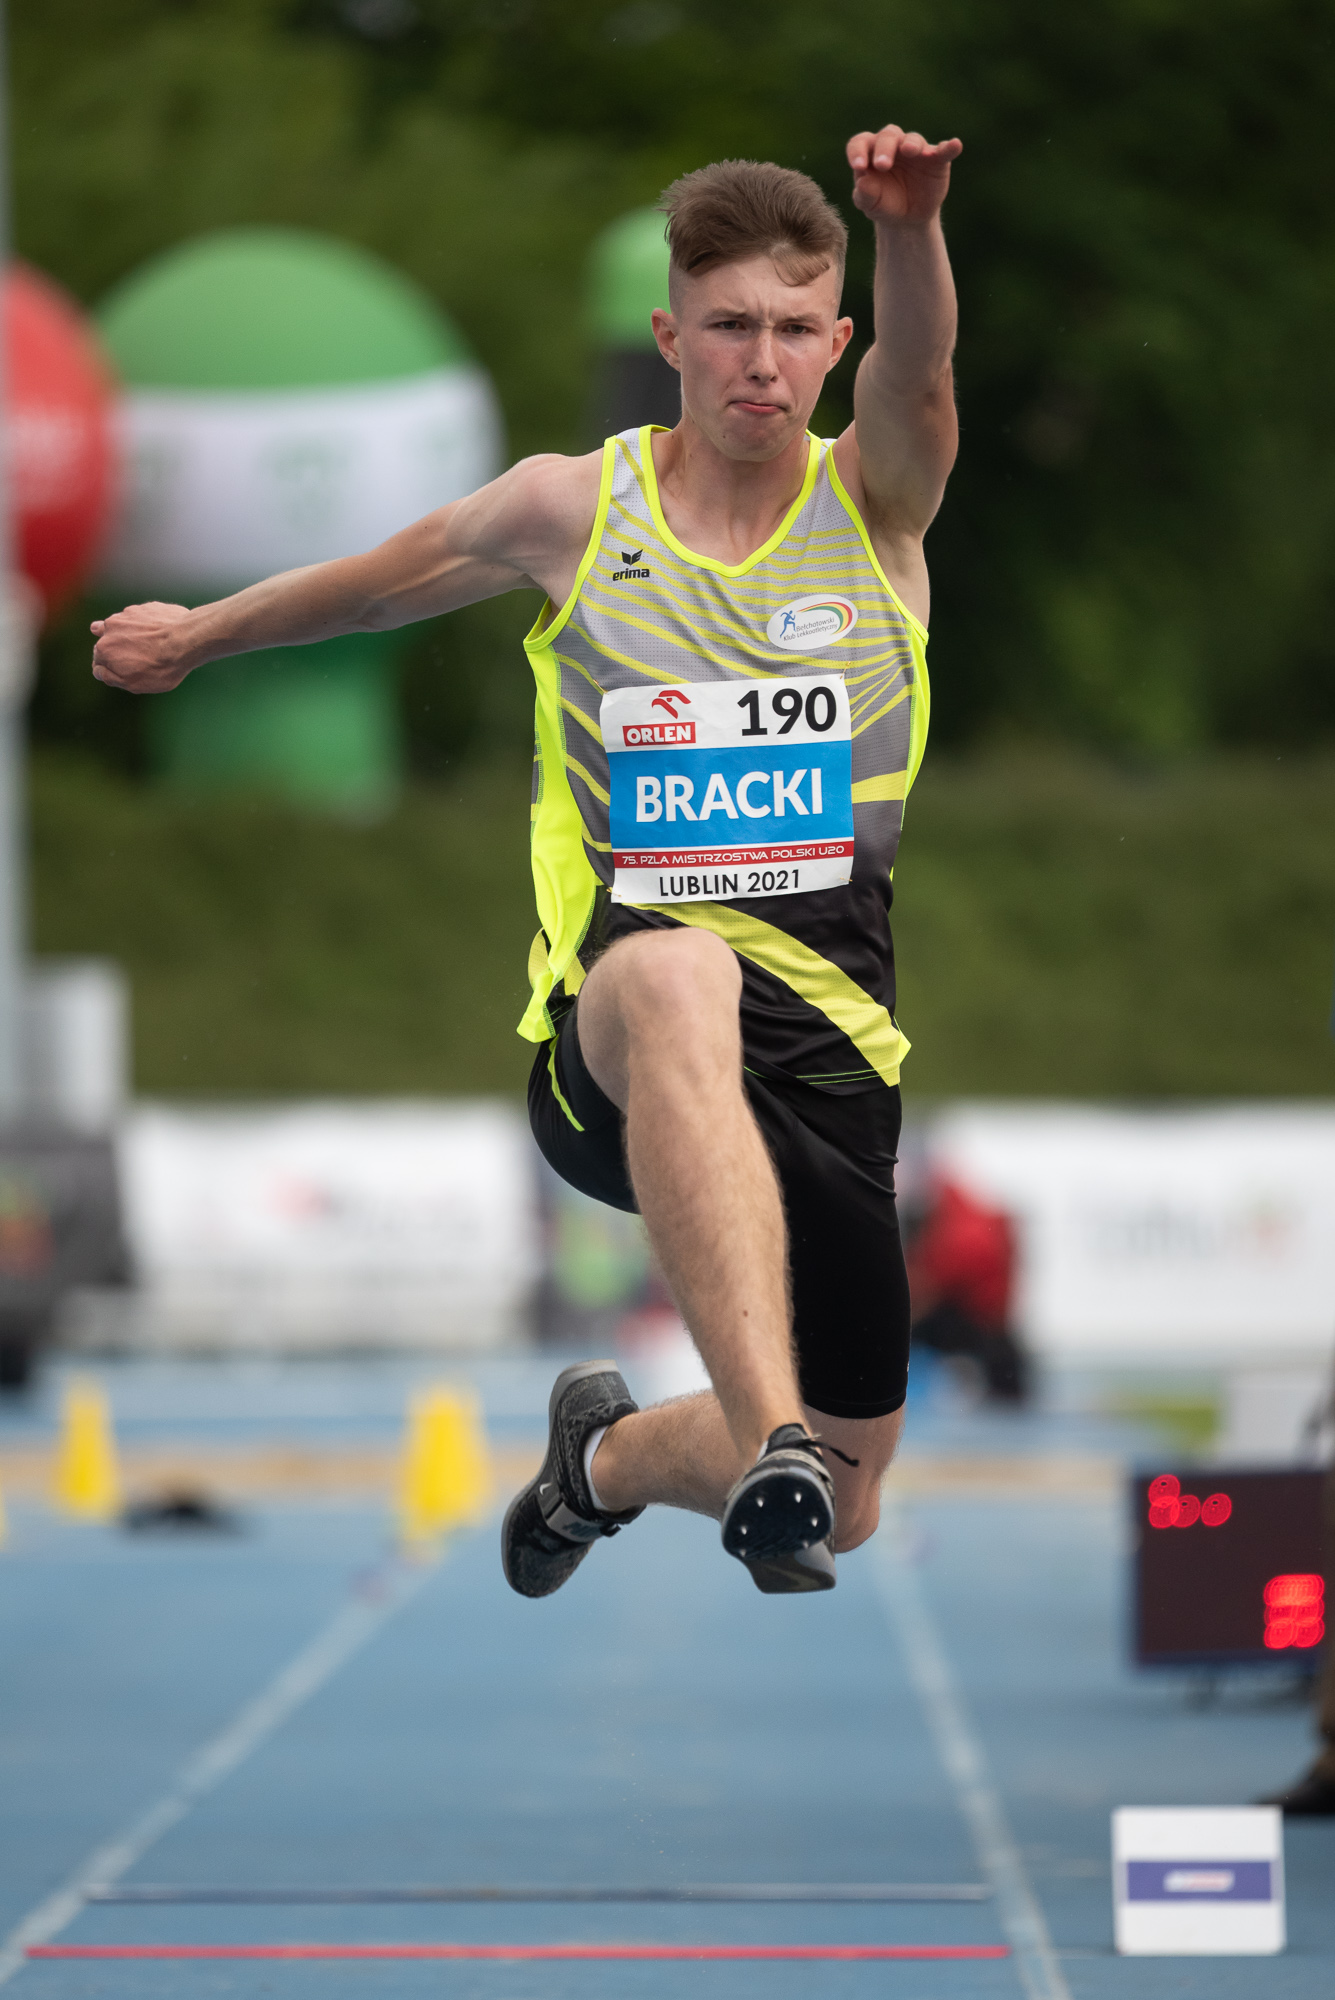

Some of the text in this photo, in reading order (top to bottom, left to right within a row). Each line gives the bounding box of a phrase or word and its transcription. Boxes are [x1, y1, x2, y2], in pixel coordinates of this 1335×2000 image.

[612, 568, 650, 581] erima
[783, 633, 796, 641] Klub
[737, 686, 837, 736] 190
[626, 725, 692, 744] ORLEN
[636, 768, 823, 823] BRACKI
[622, 845, 845, 865] 75. PZLA MISTRZOSTWA POLSKI U20
[659, 869, 799, 896] LUBLIN 2021
